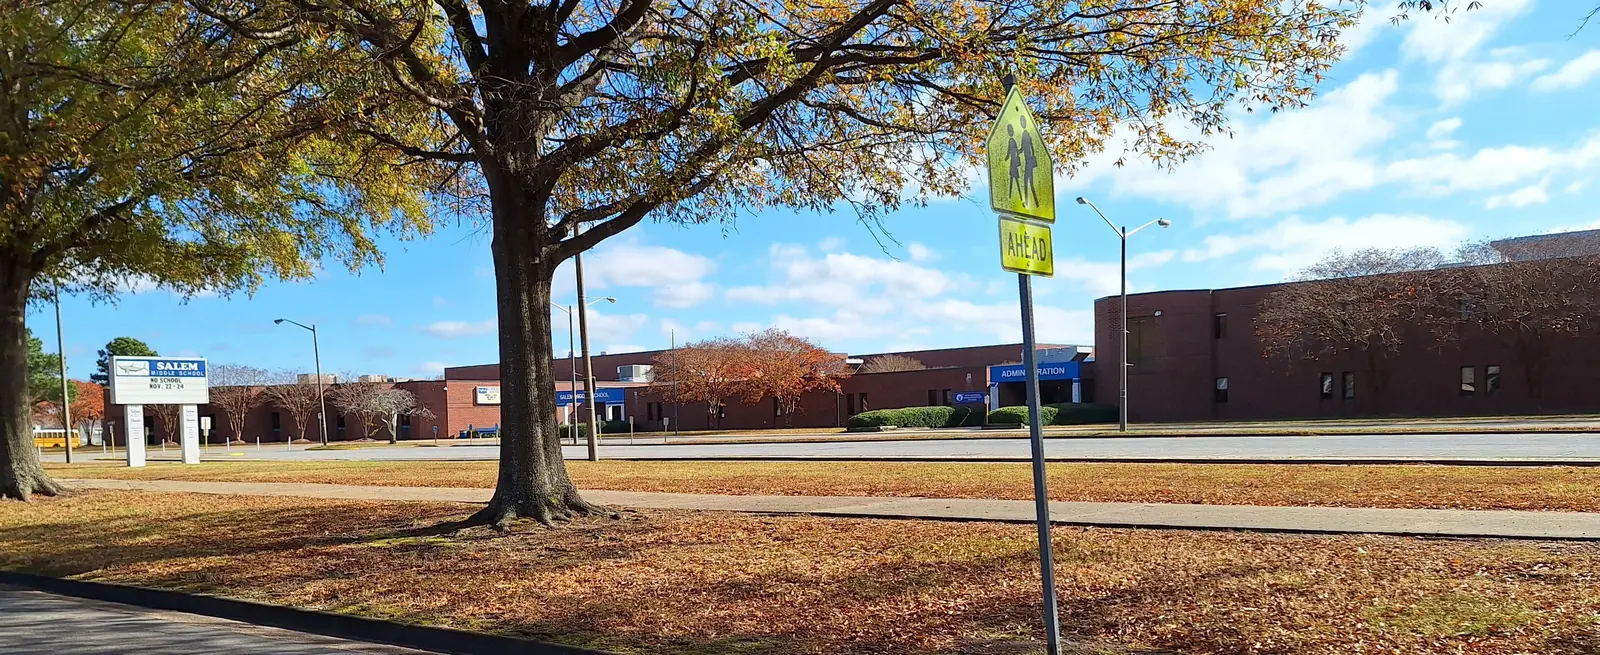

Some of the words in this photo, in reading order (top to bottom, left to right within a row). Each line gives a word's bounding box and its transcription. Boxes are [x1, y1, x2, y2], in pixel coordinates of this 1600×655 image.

[1008, 231, 1047, 262] AHEAD
[156, 361, 199, 371] SALEM
[1001, 367, 1065, 377] ADMINRATION
